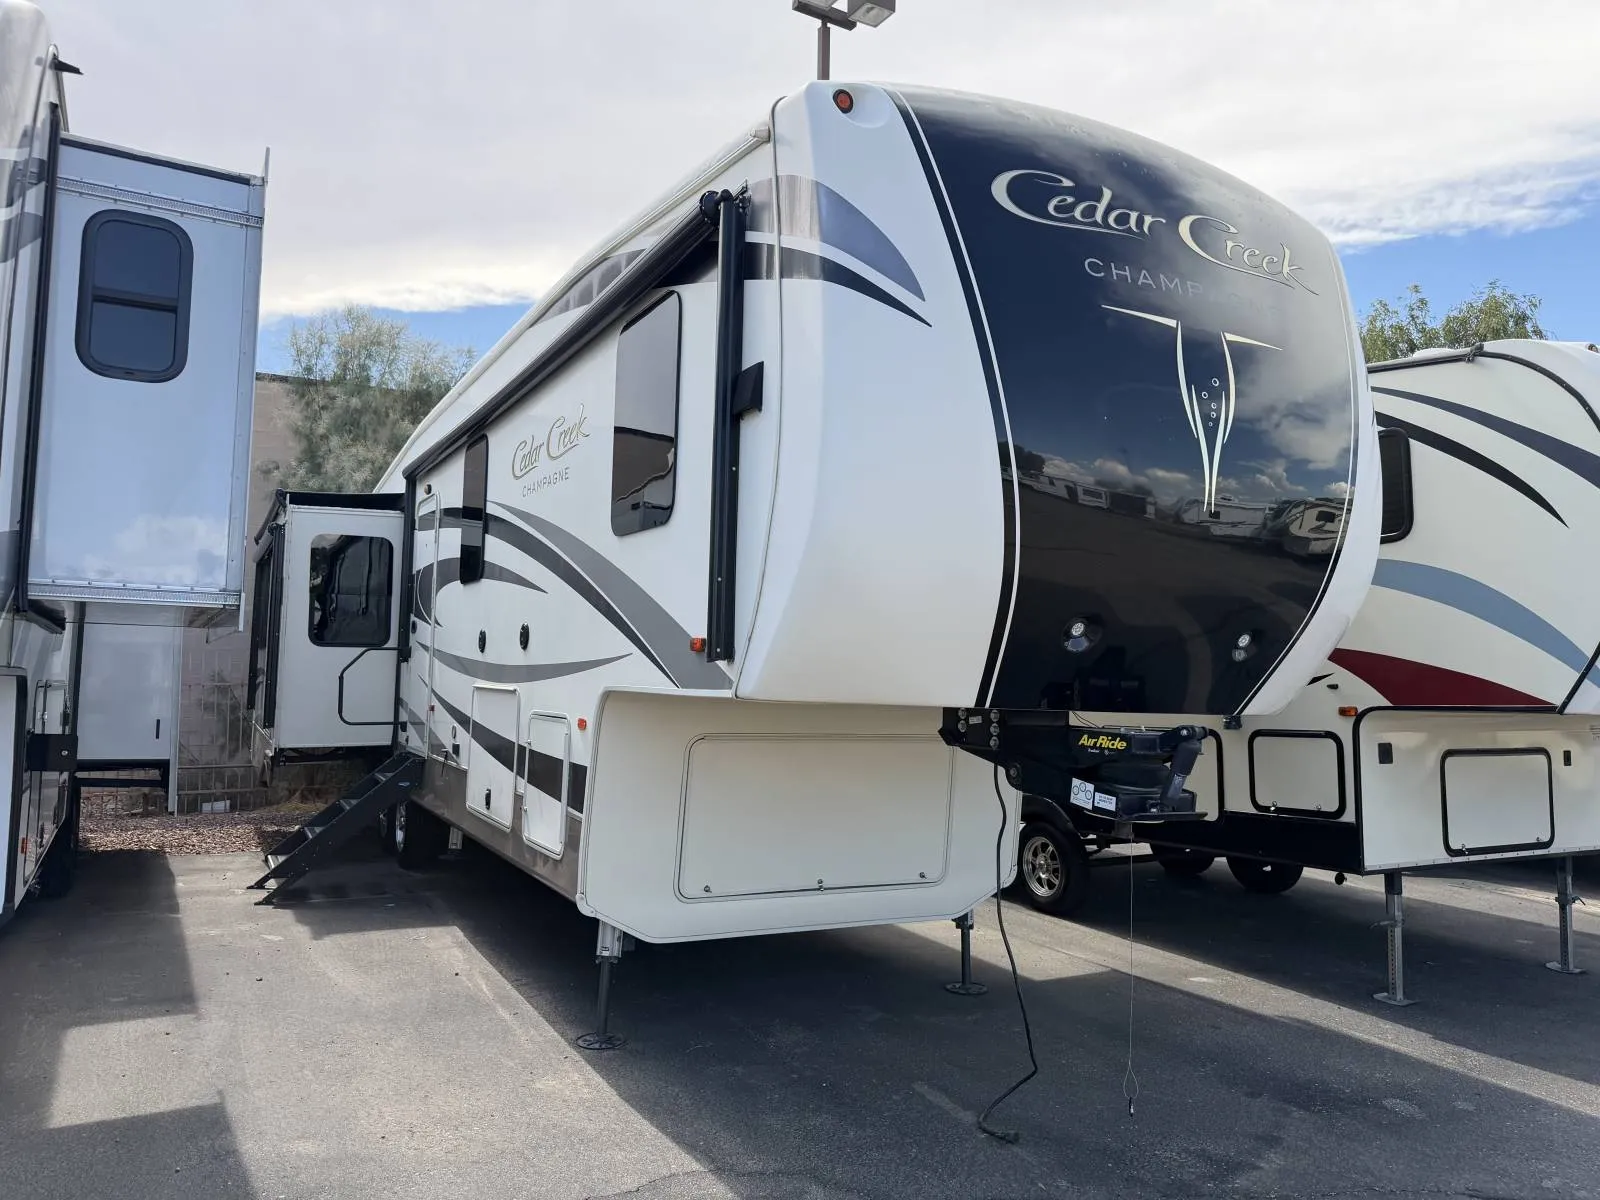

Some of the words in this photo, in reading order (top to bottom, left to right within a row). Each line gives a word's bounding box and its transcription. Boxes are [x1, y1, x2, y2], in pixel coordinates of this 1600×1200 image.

[991, 169, 1166, 241] Cedar
[1178, 214, 1319, 296] Creek
[512, 434, 544, 480] Cedar
[546, 402, 591, 461] Creek
[522, 466, 570, 498] CHAMPAGNE
